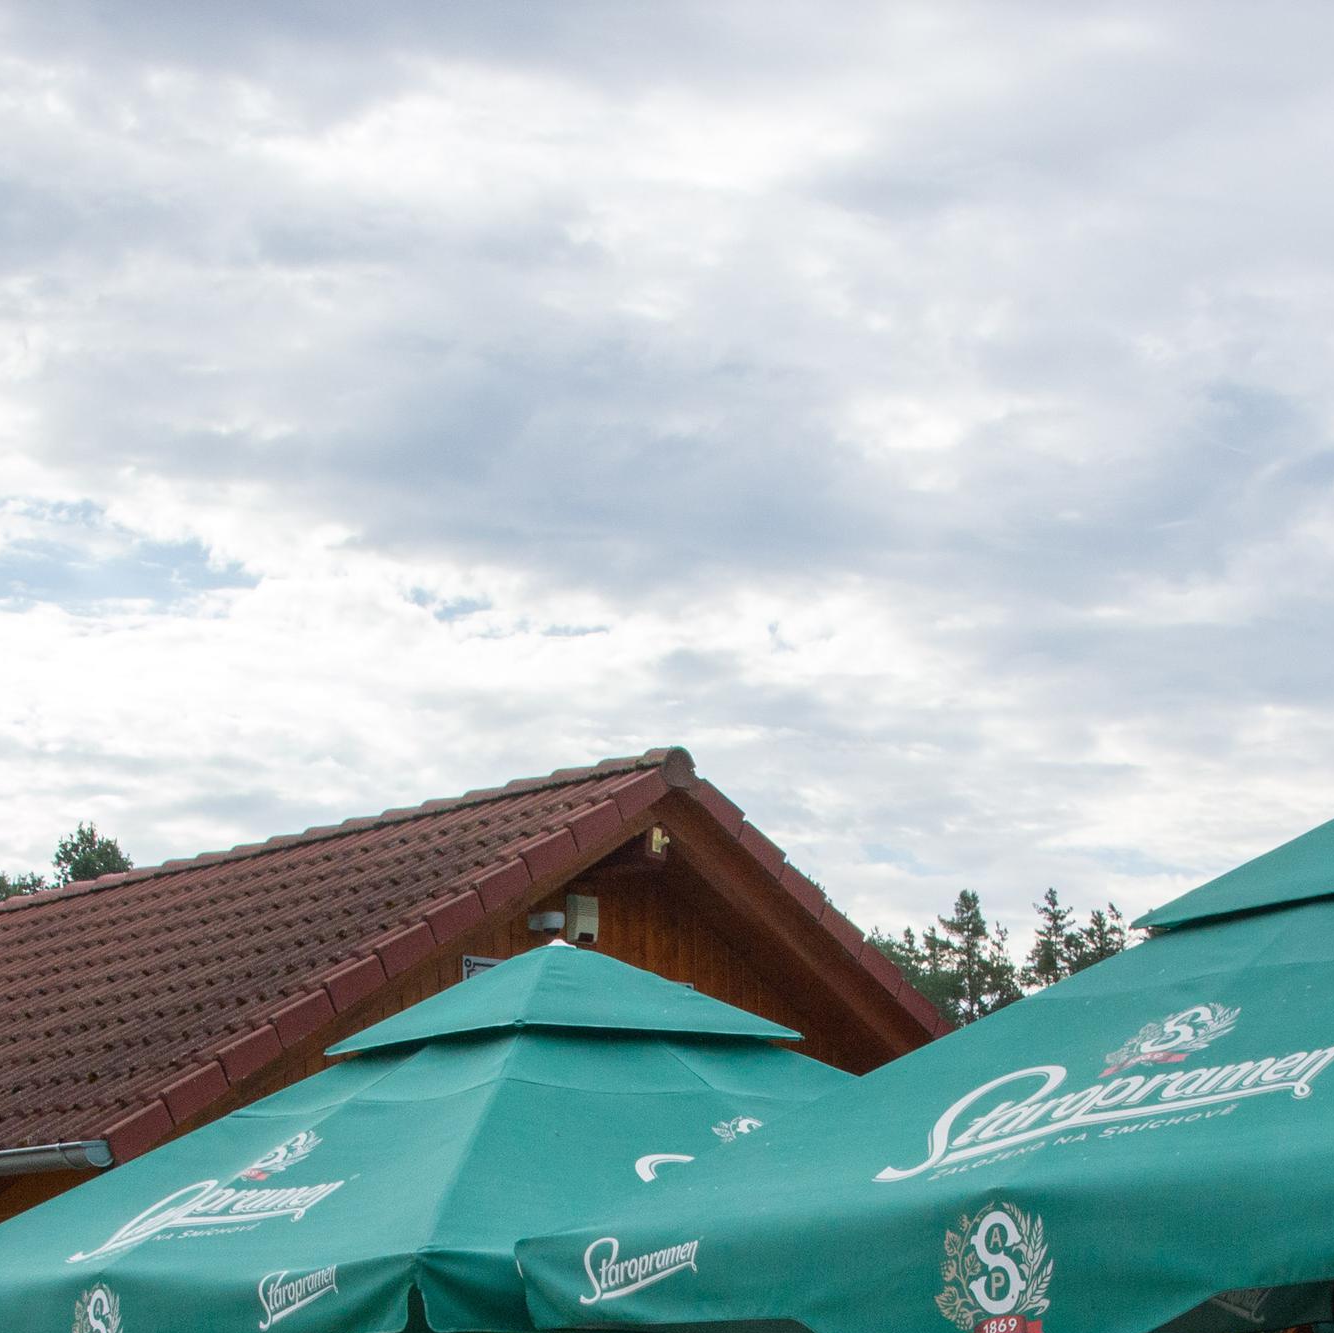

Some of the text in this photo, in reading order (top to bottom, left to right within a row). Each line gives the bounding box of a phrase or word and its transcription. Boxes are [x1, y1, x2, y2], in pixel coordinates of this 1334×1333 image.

[1054, 1133, 1087, 1146] NA
[1099, 1103, 1242, 1137] SMÍCHOVĚ
[258, 1264, 339, 1332] Staropramen
[579, 1237, 698, 1304] Staropramen
